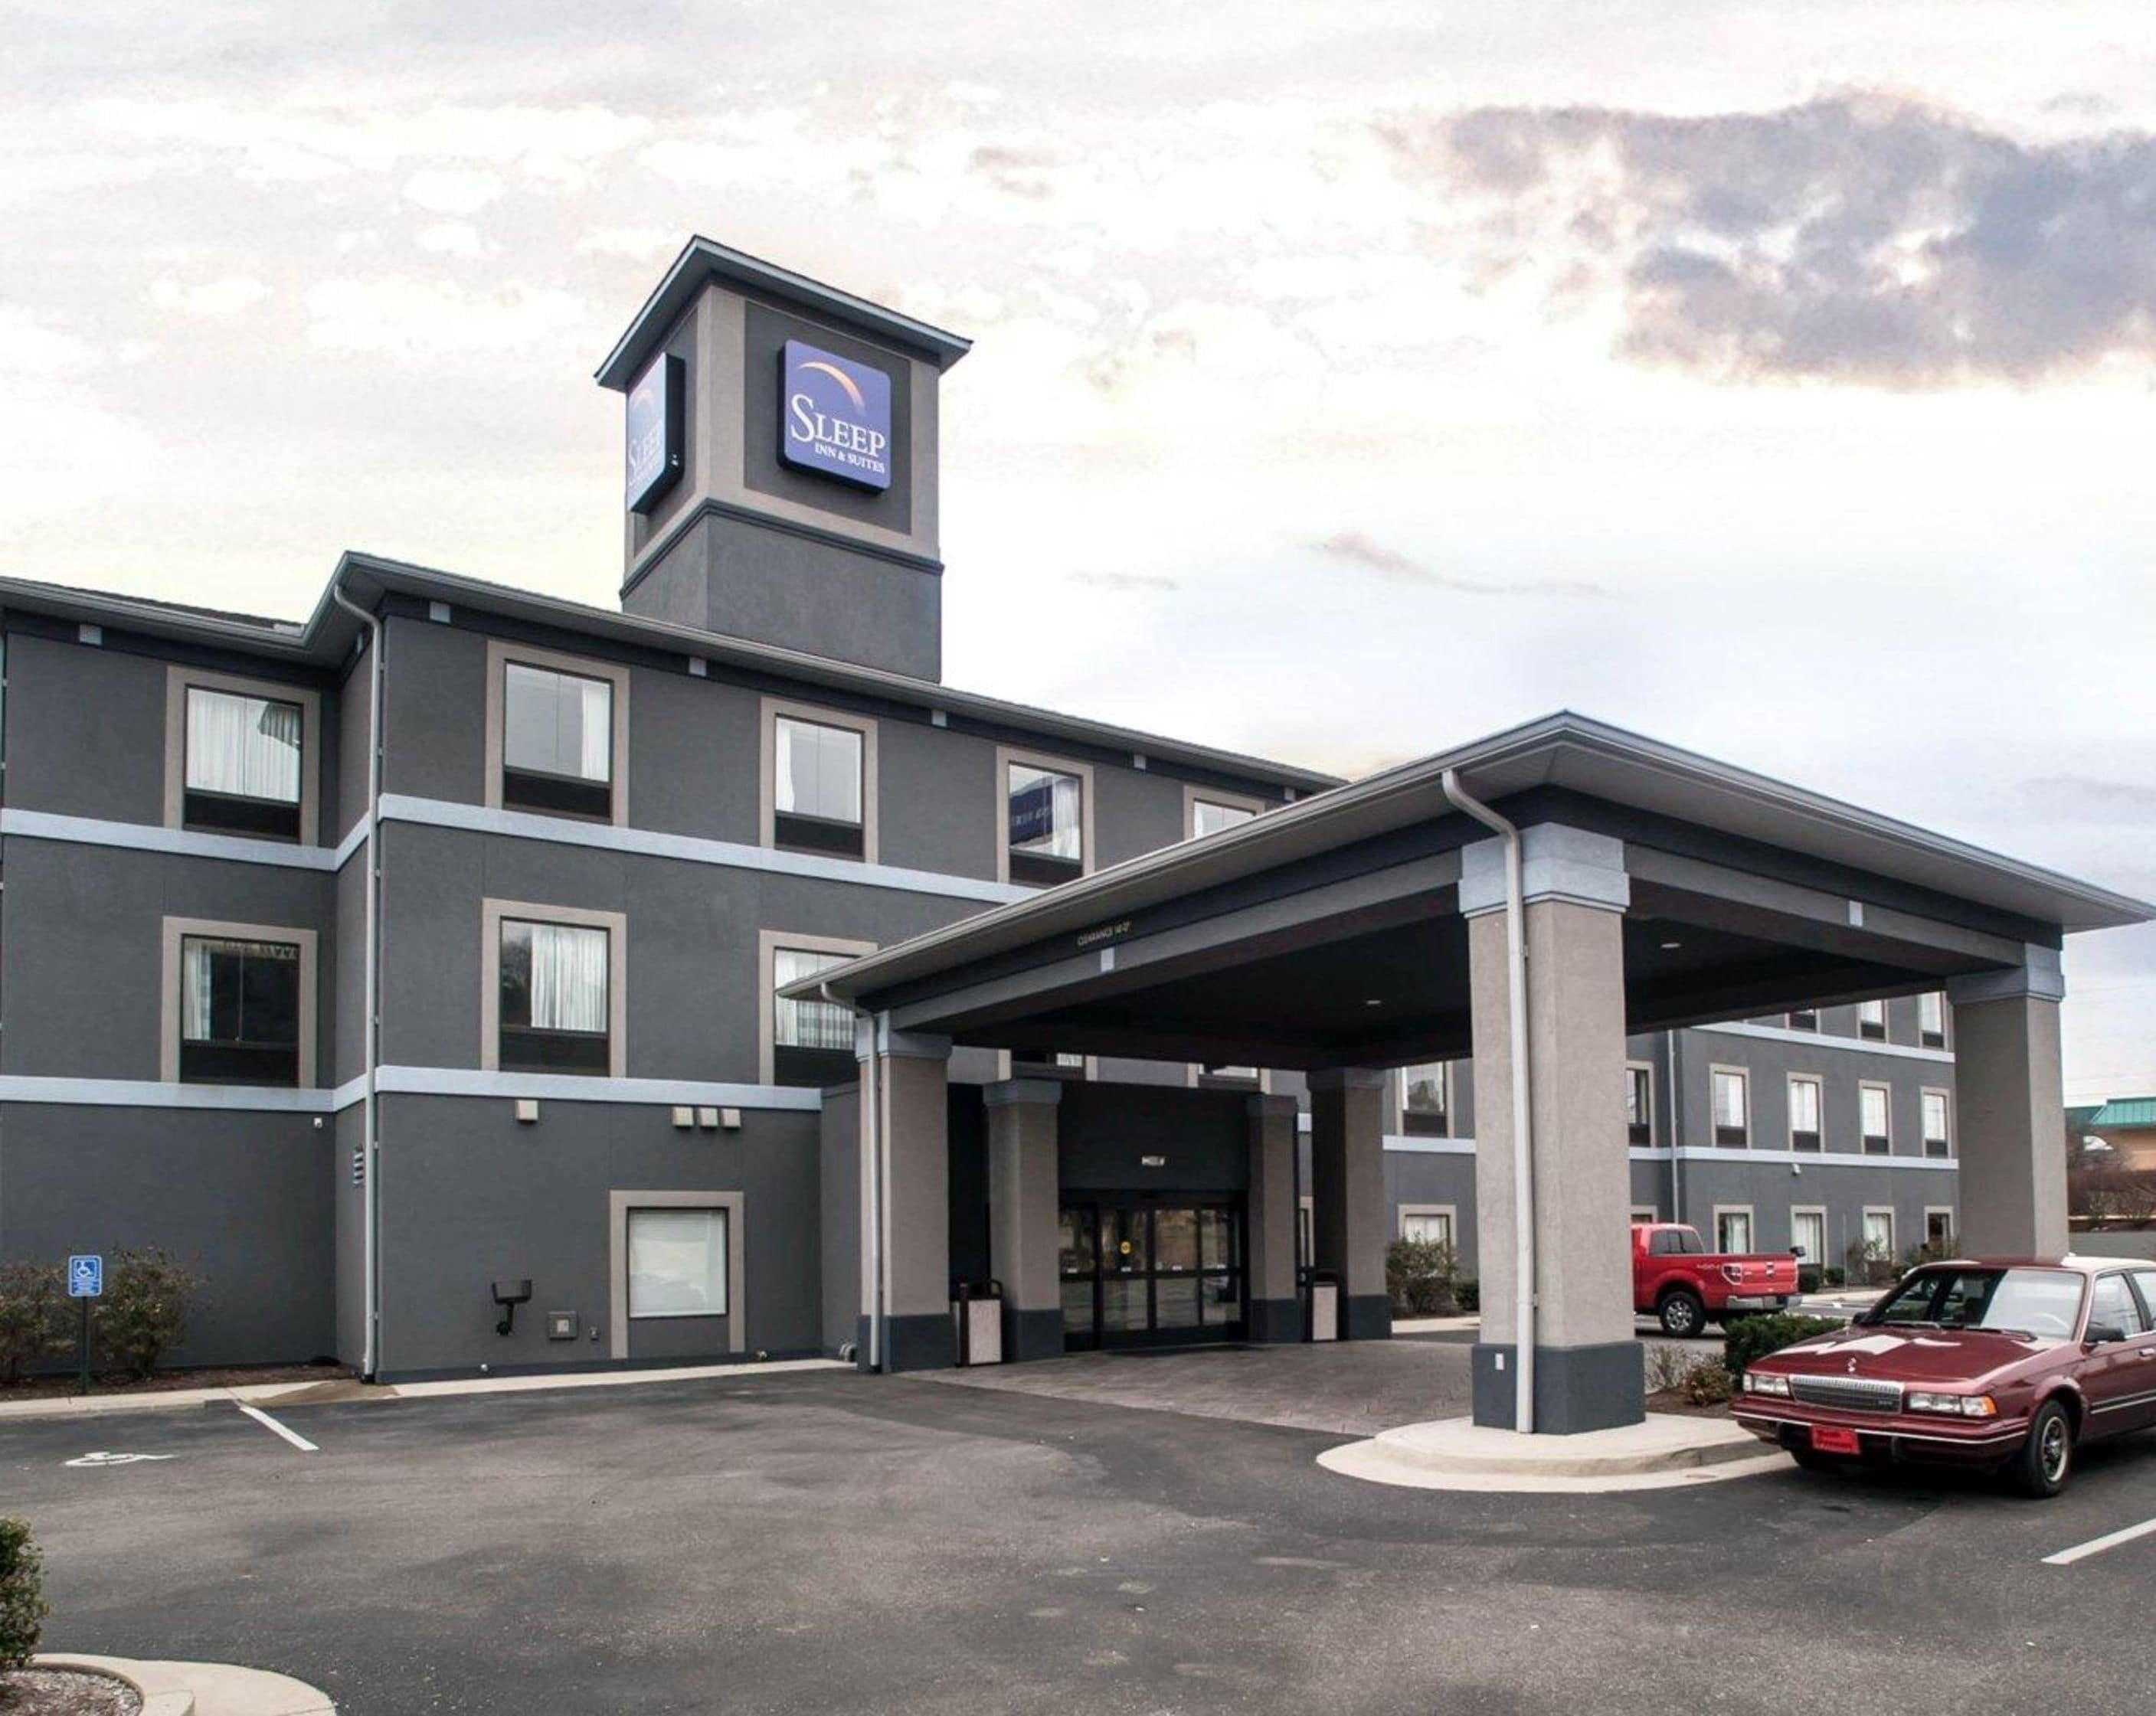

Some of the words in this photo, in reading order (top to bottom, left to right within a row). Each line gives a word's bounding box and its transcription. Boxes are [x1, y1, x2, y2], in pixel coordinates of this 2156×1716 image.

[790, 394, 885, 457] SLEEP
[814, 443, 836, 459] INN
[838, 449, 846, 462] &
[847, 453, 885, 475] SUITES
